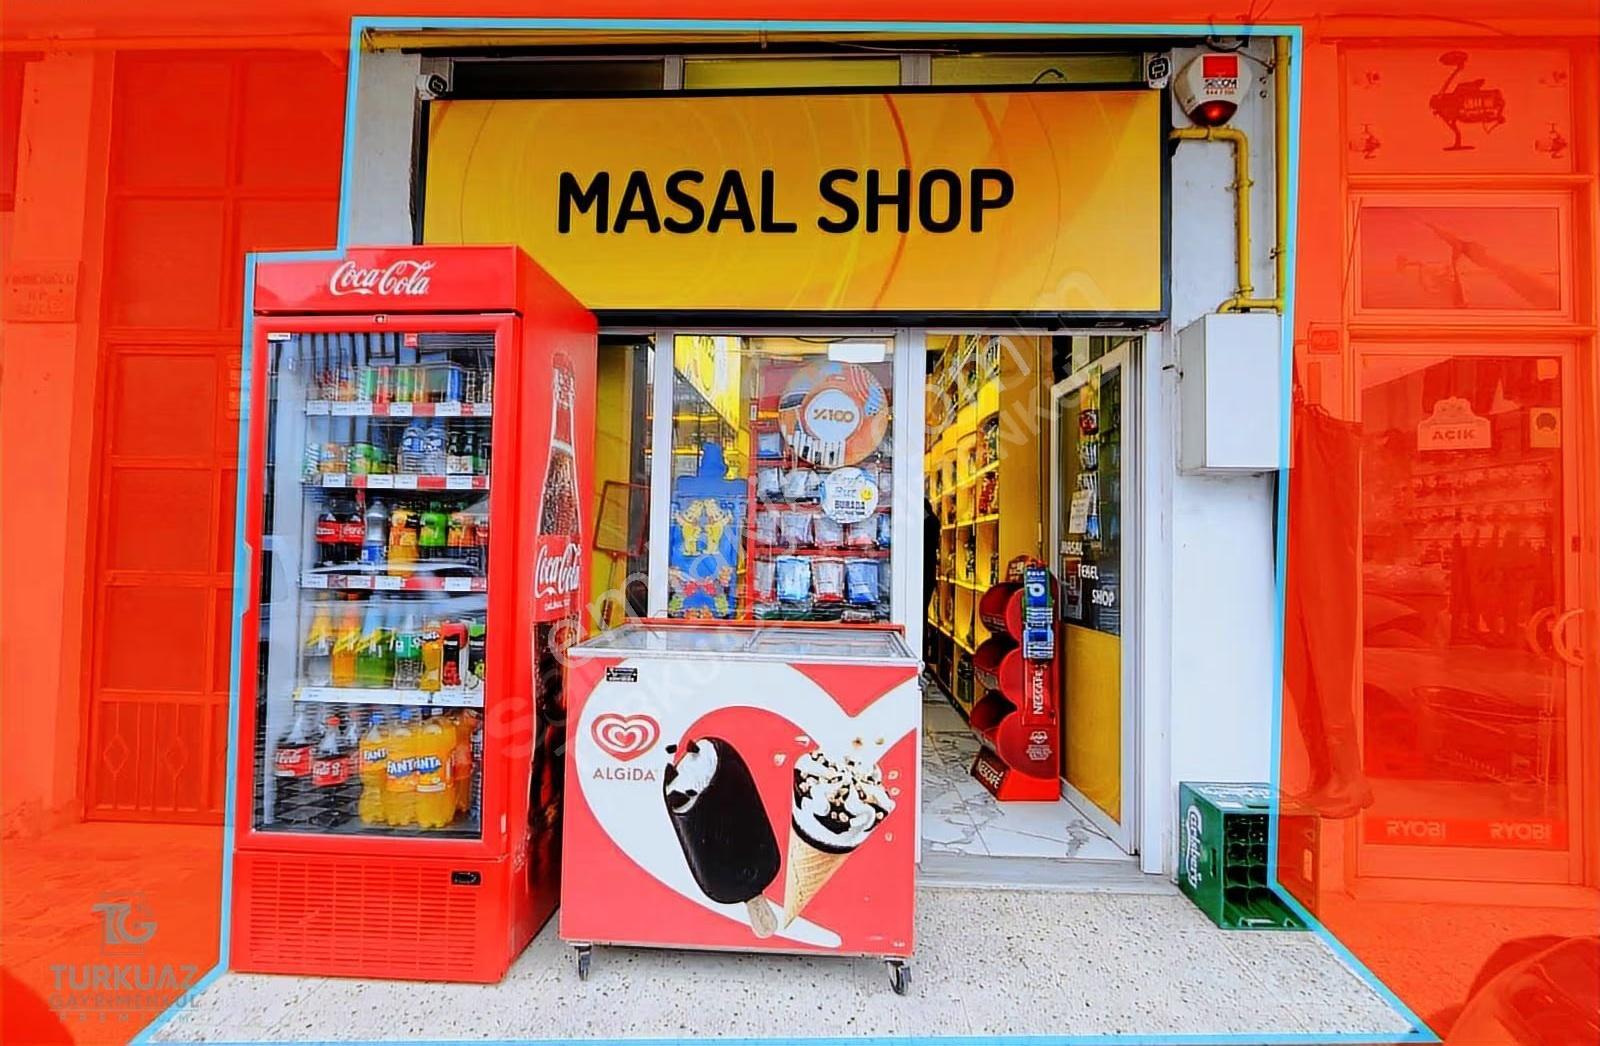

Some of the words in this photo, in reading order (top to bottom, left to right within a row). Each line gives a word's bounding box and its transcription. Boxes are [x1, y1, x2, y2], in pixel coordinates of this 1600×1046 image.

[558, 169, 798, 234] MASAL
[817, 168, 1015, 234] SHOP
[329, 259, 437, 297] Coca-Cola
[1060, 541, 1084, 556] MASAL
[1092, 589, 1115, 607] SHOP
[1386, 820, 1447, 840] RYOBI
[1488, 822, 1551, 841] RYOBI
